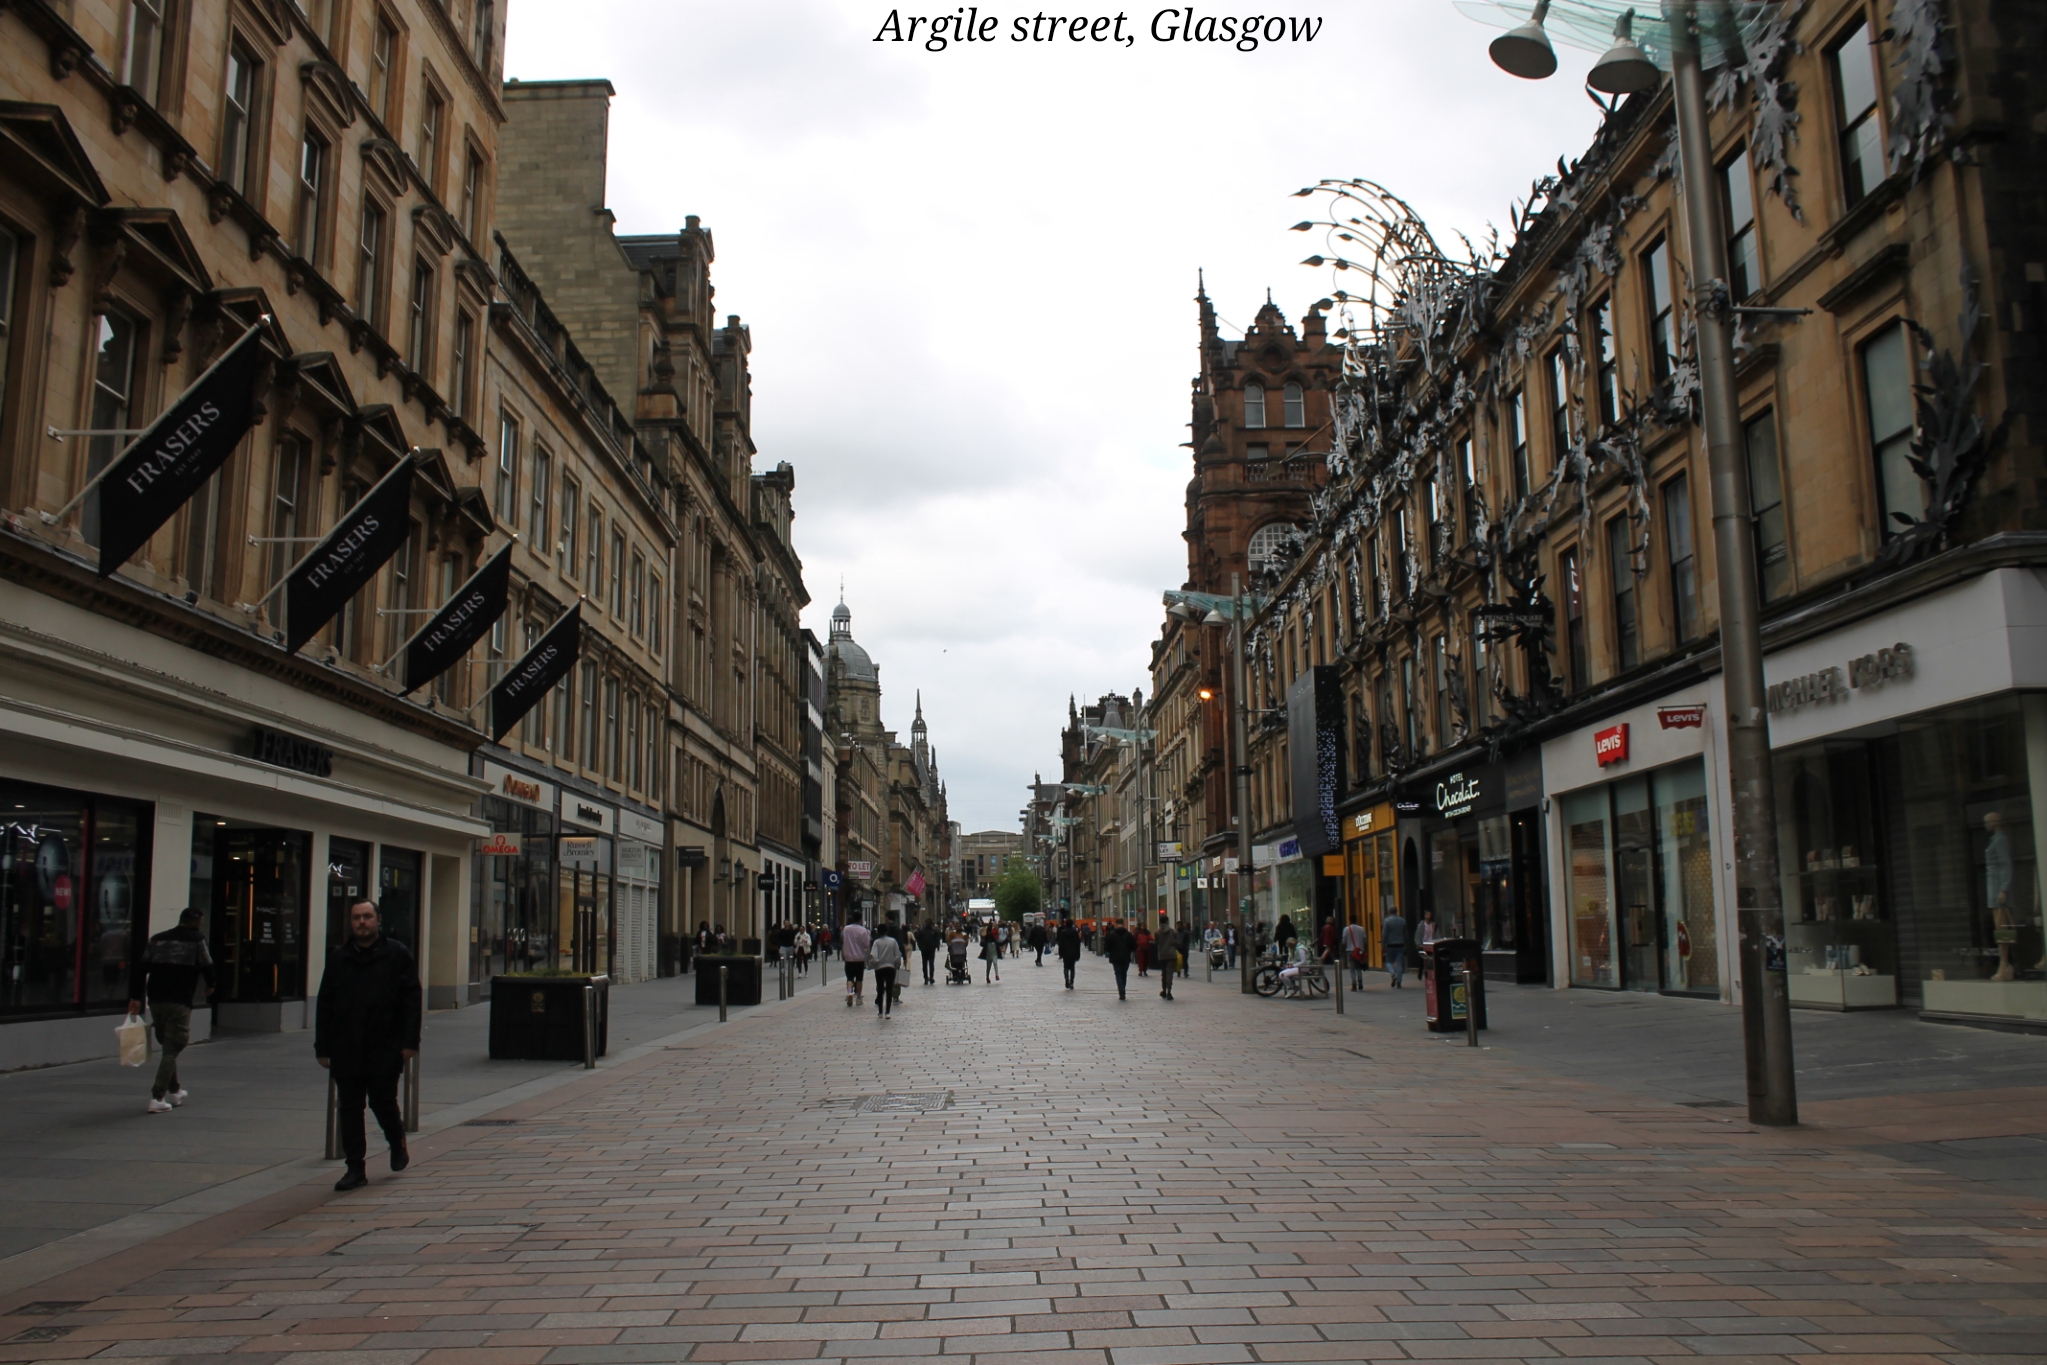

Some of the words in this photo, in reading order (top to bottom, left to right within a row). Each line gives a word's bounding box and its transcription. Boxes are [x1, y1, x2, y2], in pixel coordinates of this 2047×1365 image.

[127, 401, 220, 494] FRASERS
[307, 515, 379, 589] FRASERS
[423, 591, 485, 652] FRASERS
[505, 645, 558, 697] FRASERS
[1848, 642, 1912, 689] KORS
[259, 730, 332, 777] FRASERS
[1449, 772, 1464, 784] HOTEL
[483, 845, 518, 853] OMEGA
